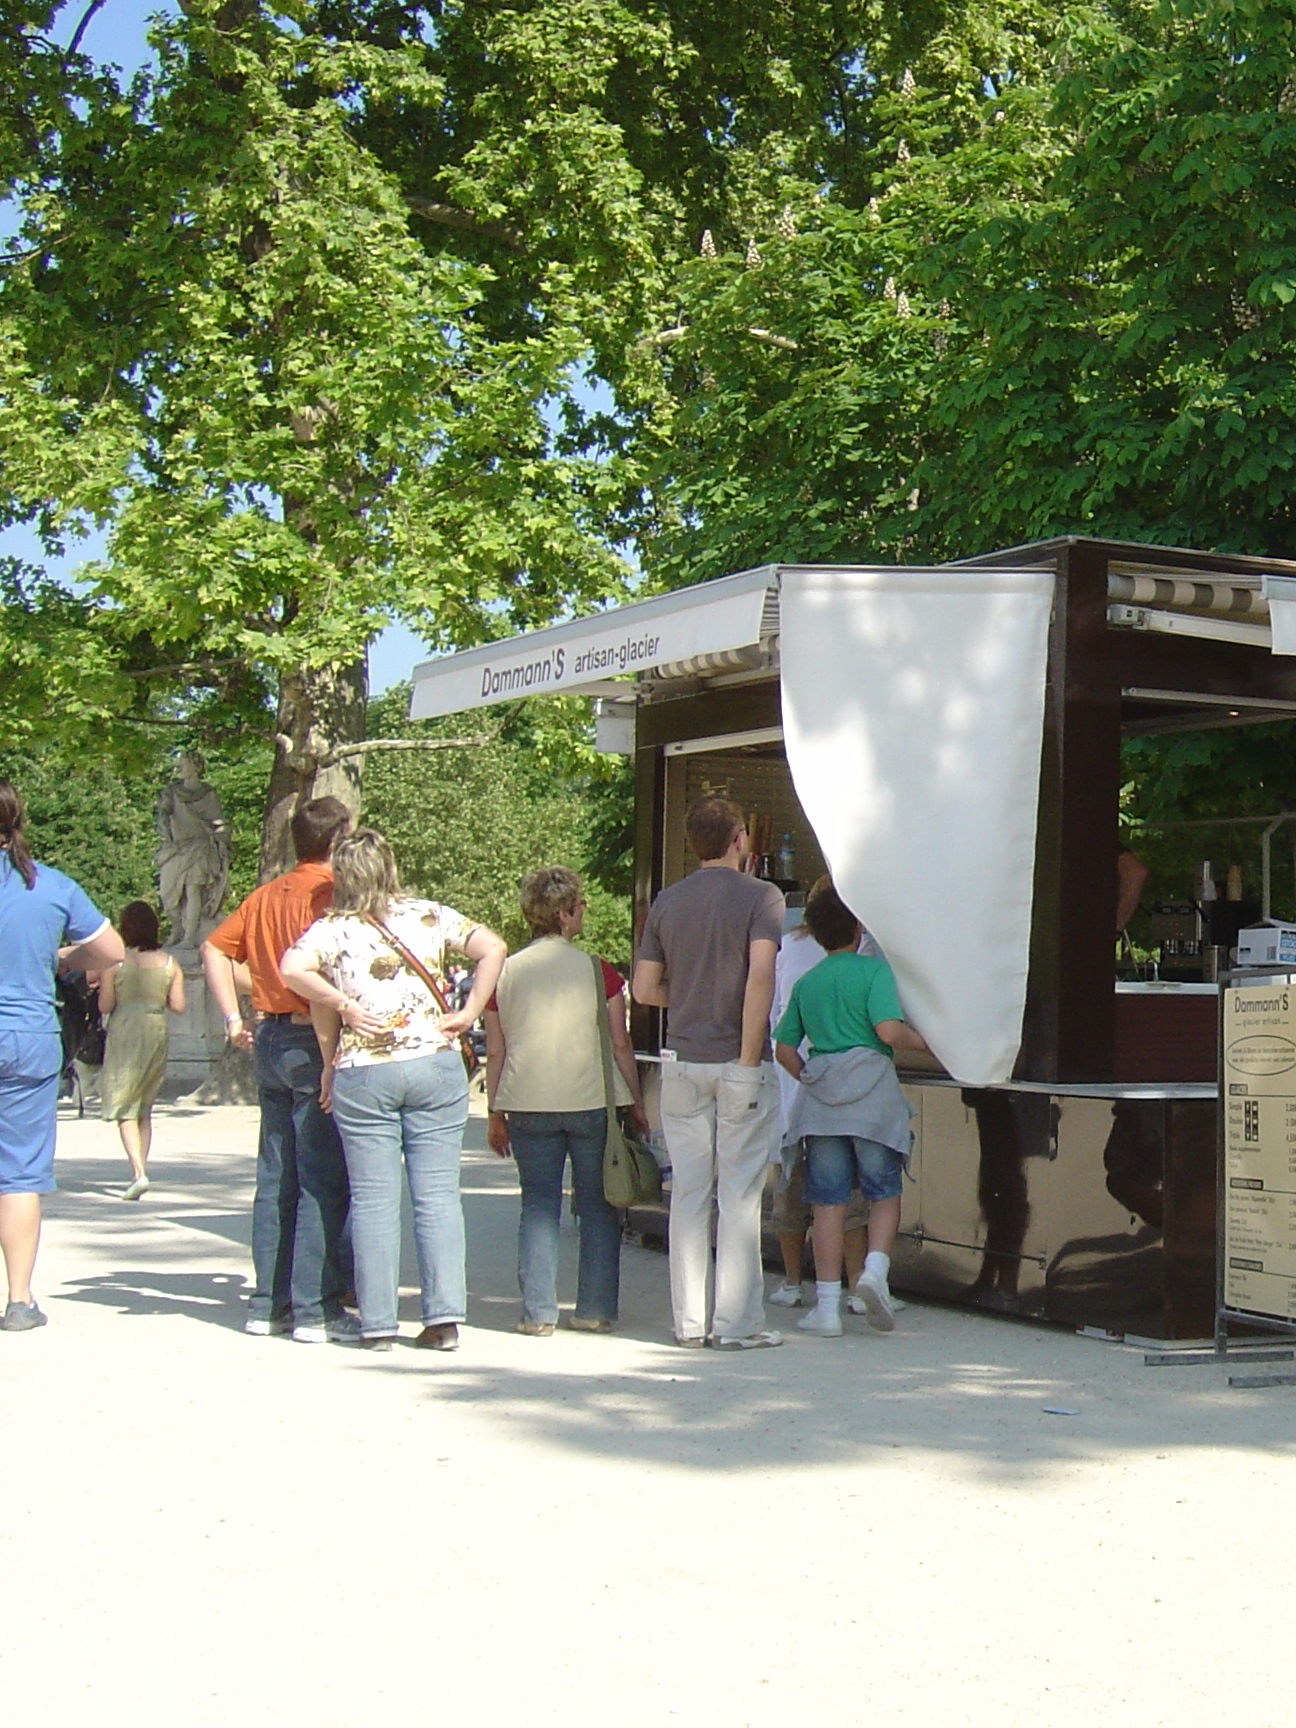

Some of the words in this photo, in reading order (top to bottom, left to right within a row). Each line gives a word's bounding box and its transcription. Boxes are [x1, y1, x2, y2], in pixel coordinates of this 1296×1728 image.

[481, 648, 565, 697] Dammann'S
[575, 634, 660, 673] artisan-glacier
[1235, 993, 1288, 1013] Dammann'S
